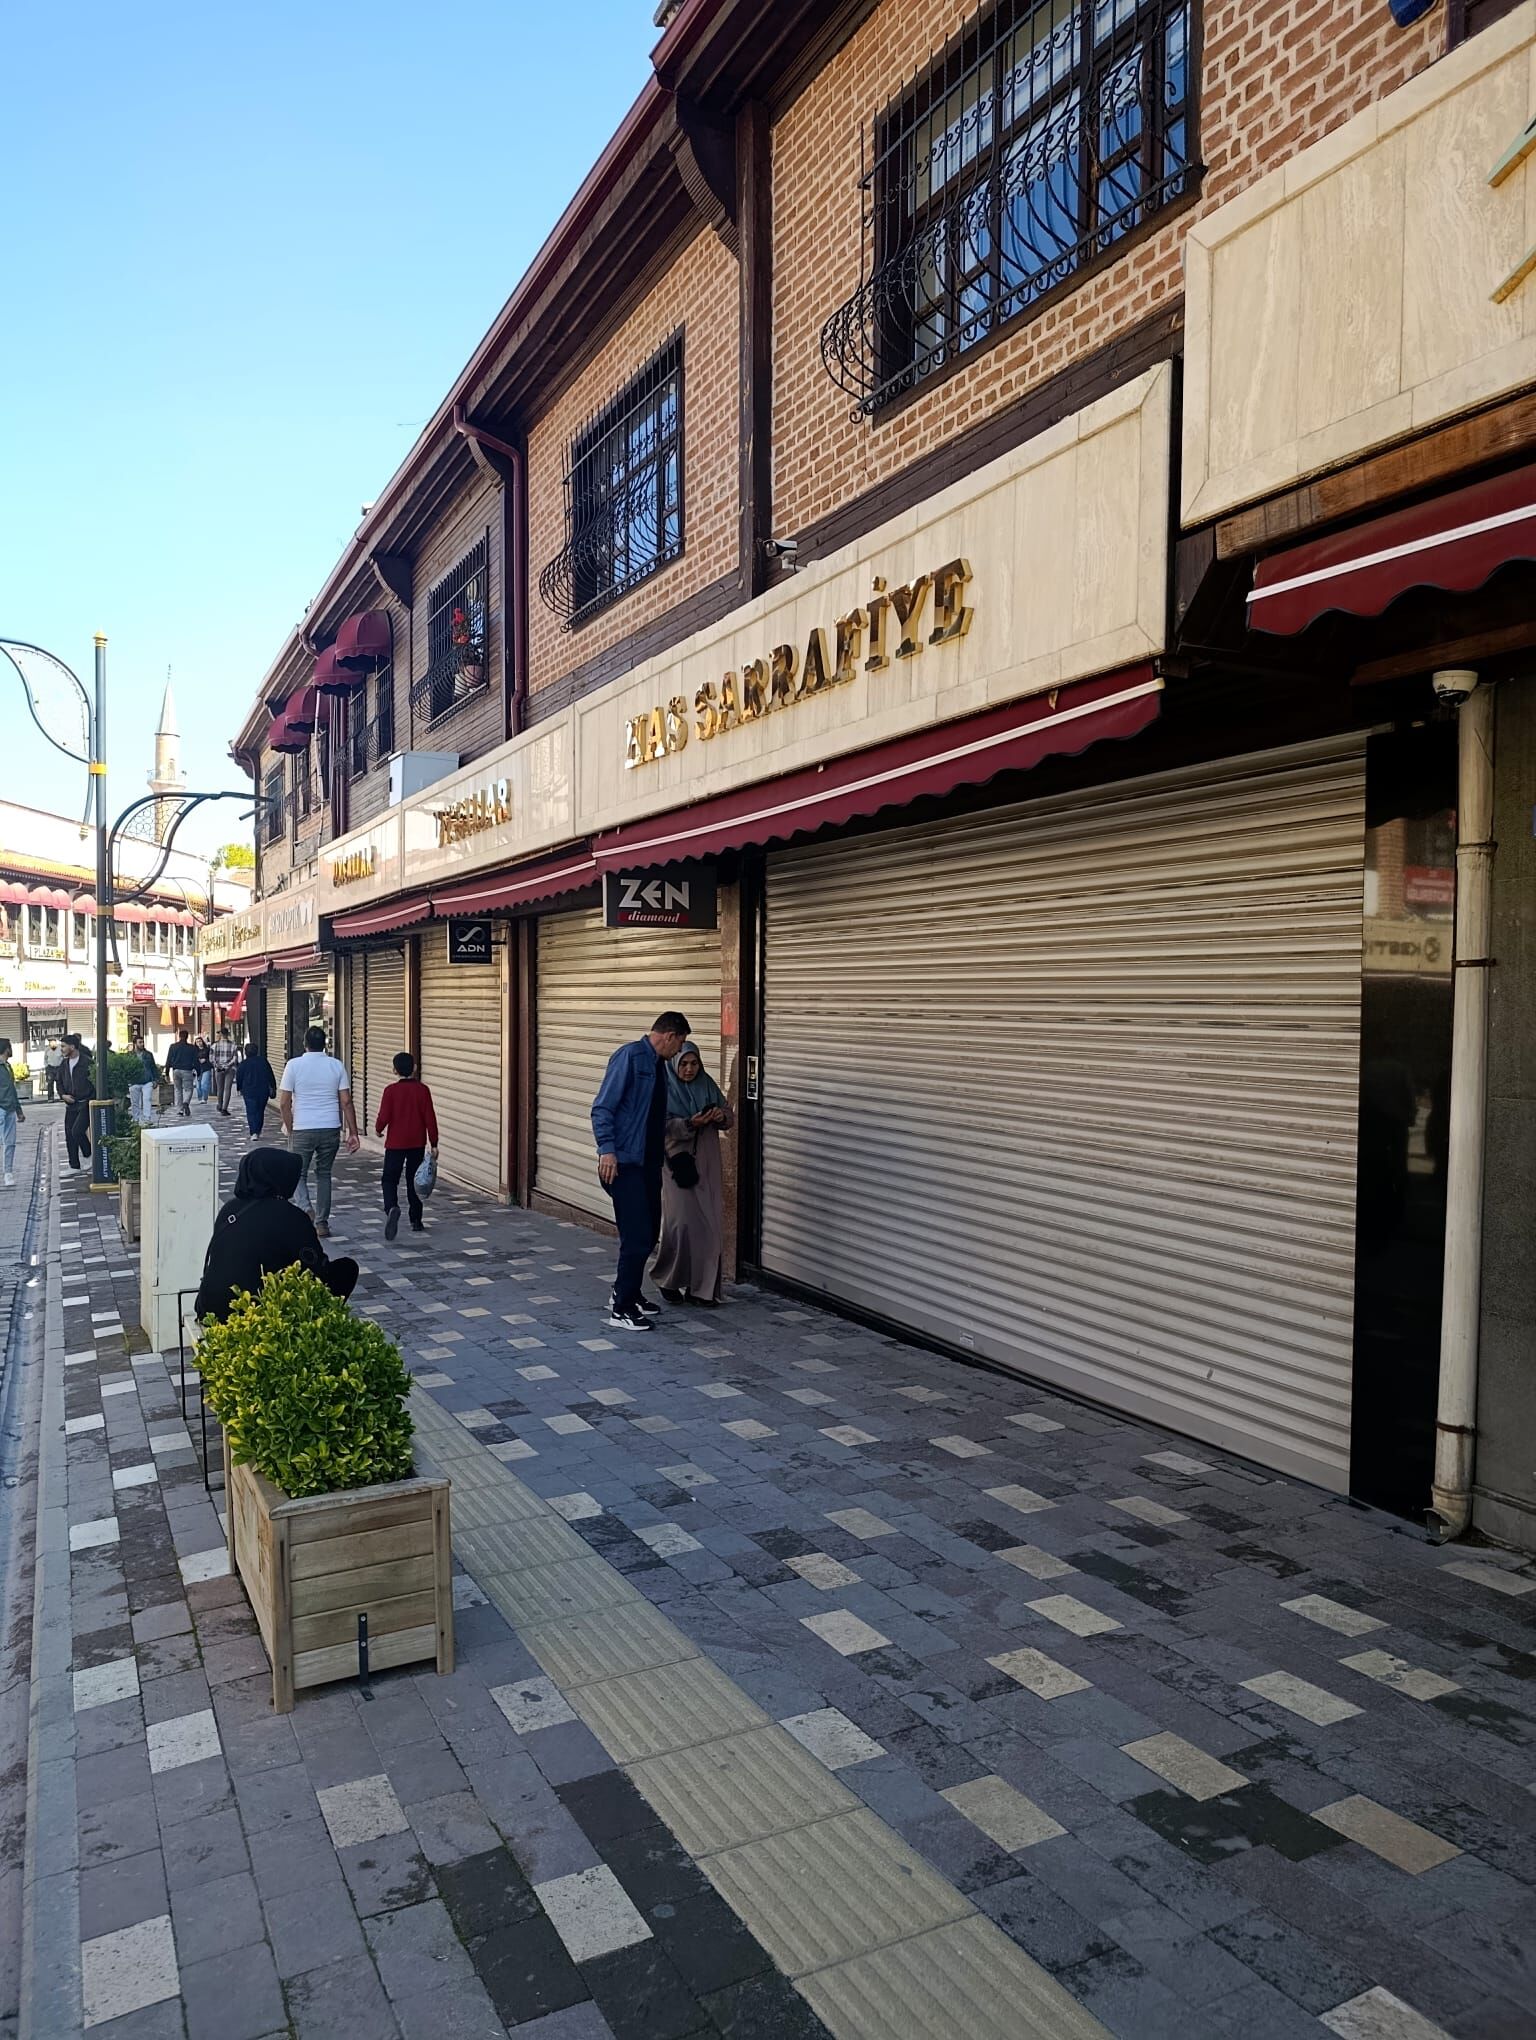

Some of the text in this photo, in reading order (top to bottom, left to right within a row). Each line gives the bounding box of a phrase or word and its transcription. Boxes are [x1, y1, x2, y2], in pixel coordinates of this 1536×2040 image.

[694, 557, 975, 741] SARRAFİYE
[618, 879, 690, 910] ZEN
[628, 911, 680, 923] diamond
[457, 944, 485, 952] ADN
